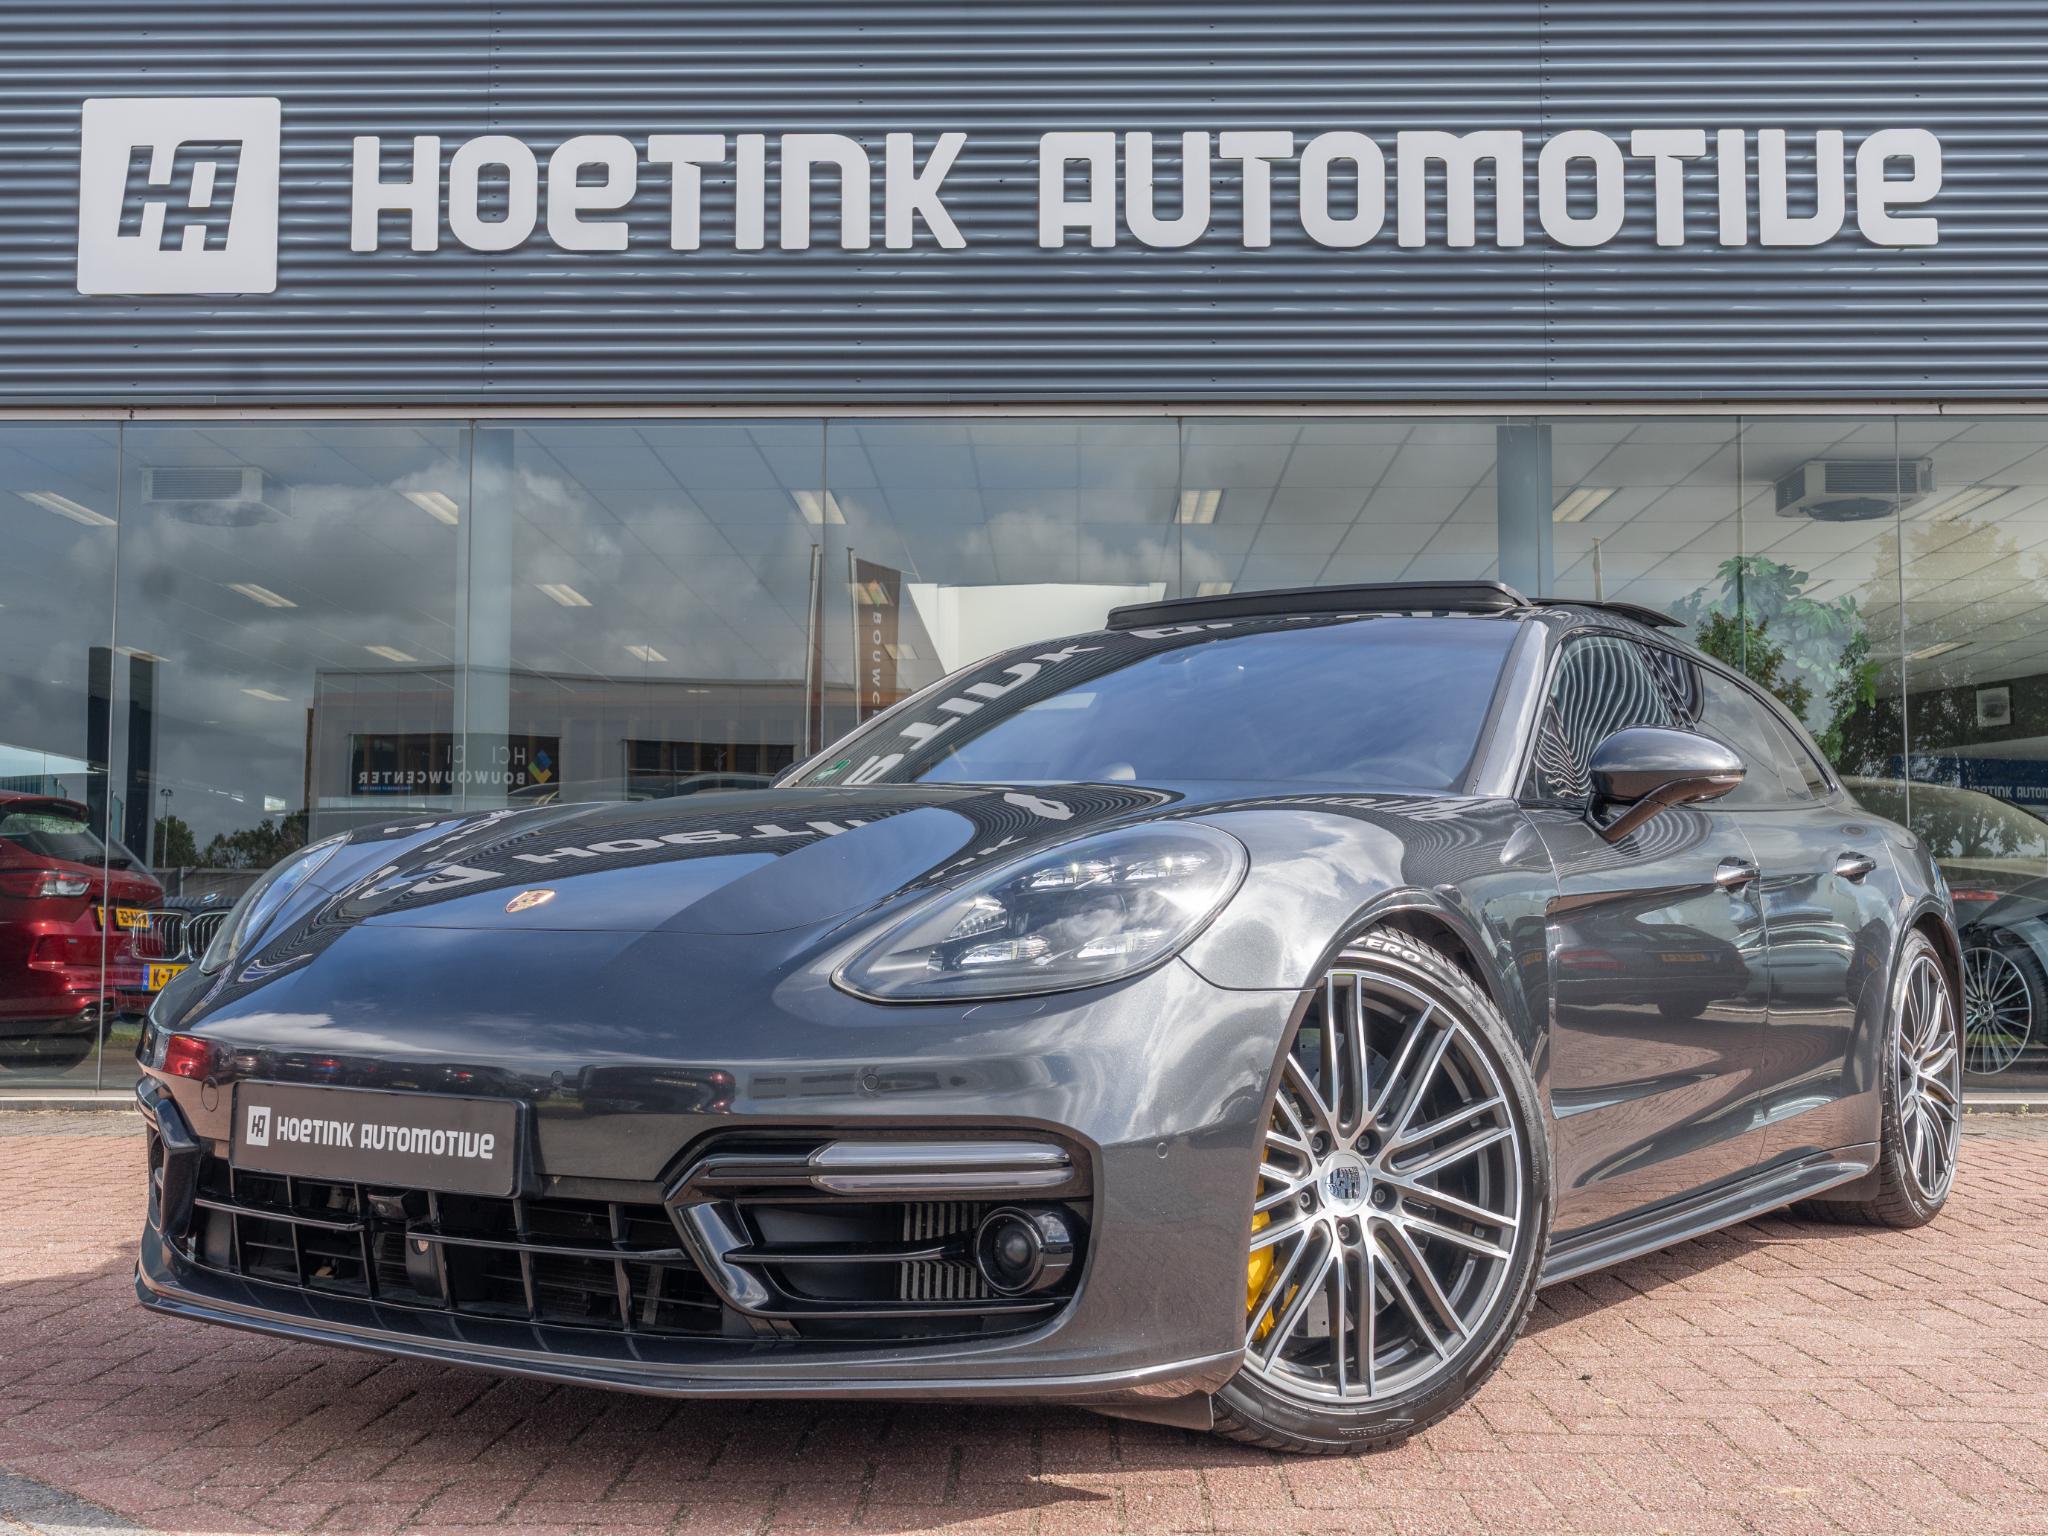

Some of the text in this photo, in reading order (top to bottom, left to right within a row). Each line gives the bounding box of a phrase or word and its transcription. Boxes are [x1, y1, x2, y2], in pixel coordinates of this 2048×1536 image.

[350, 127, 1943, 252] HOETINK AUTOMOTIVE
[872, 611, 883, 715] BOUWC
[1963, 784, 2014, 799] ETINK
[276, 1115, 496, 1160] HOETINK AUTOMOTIVE
